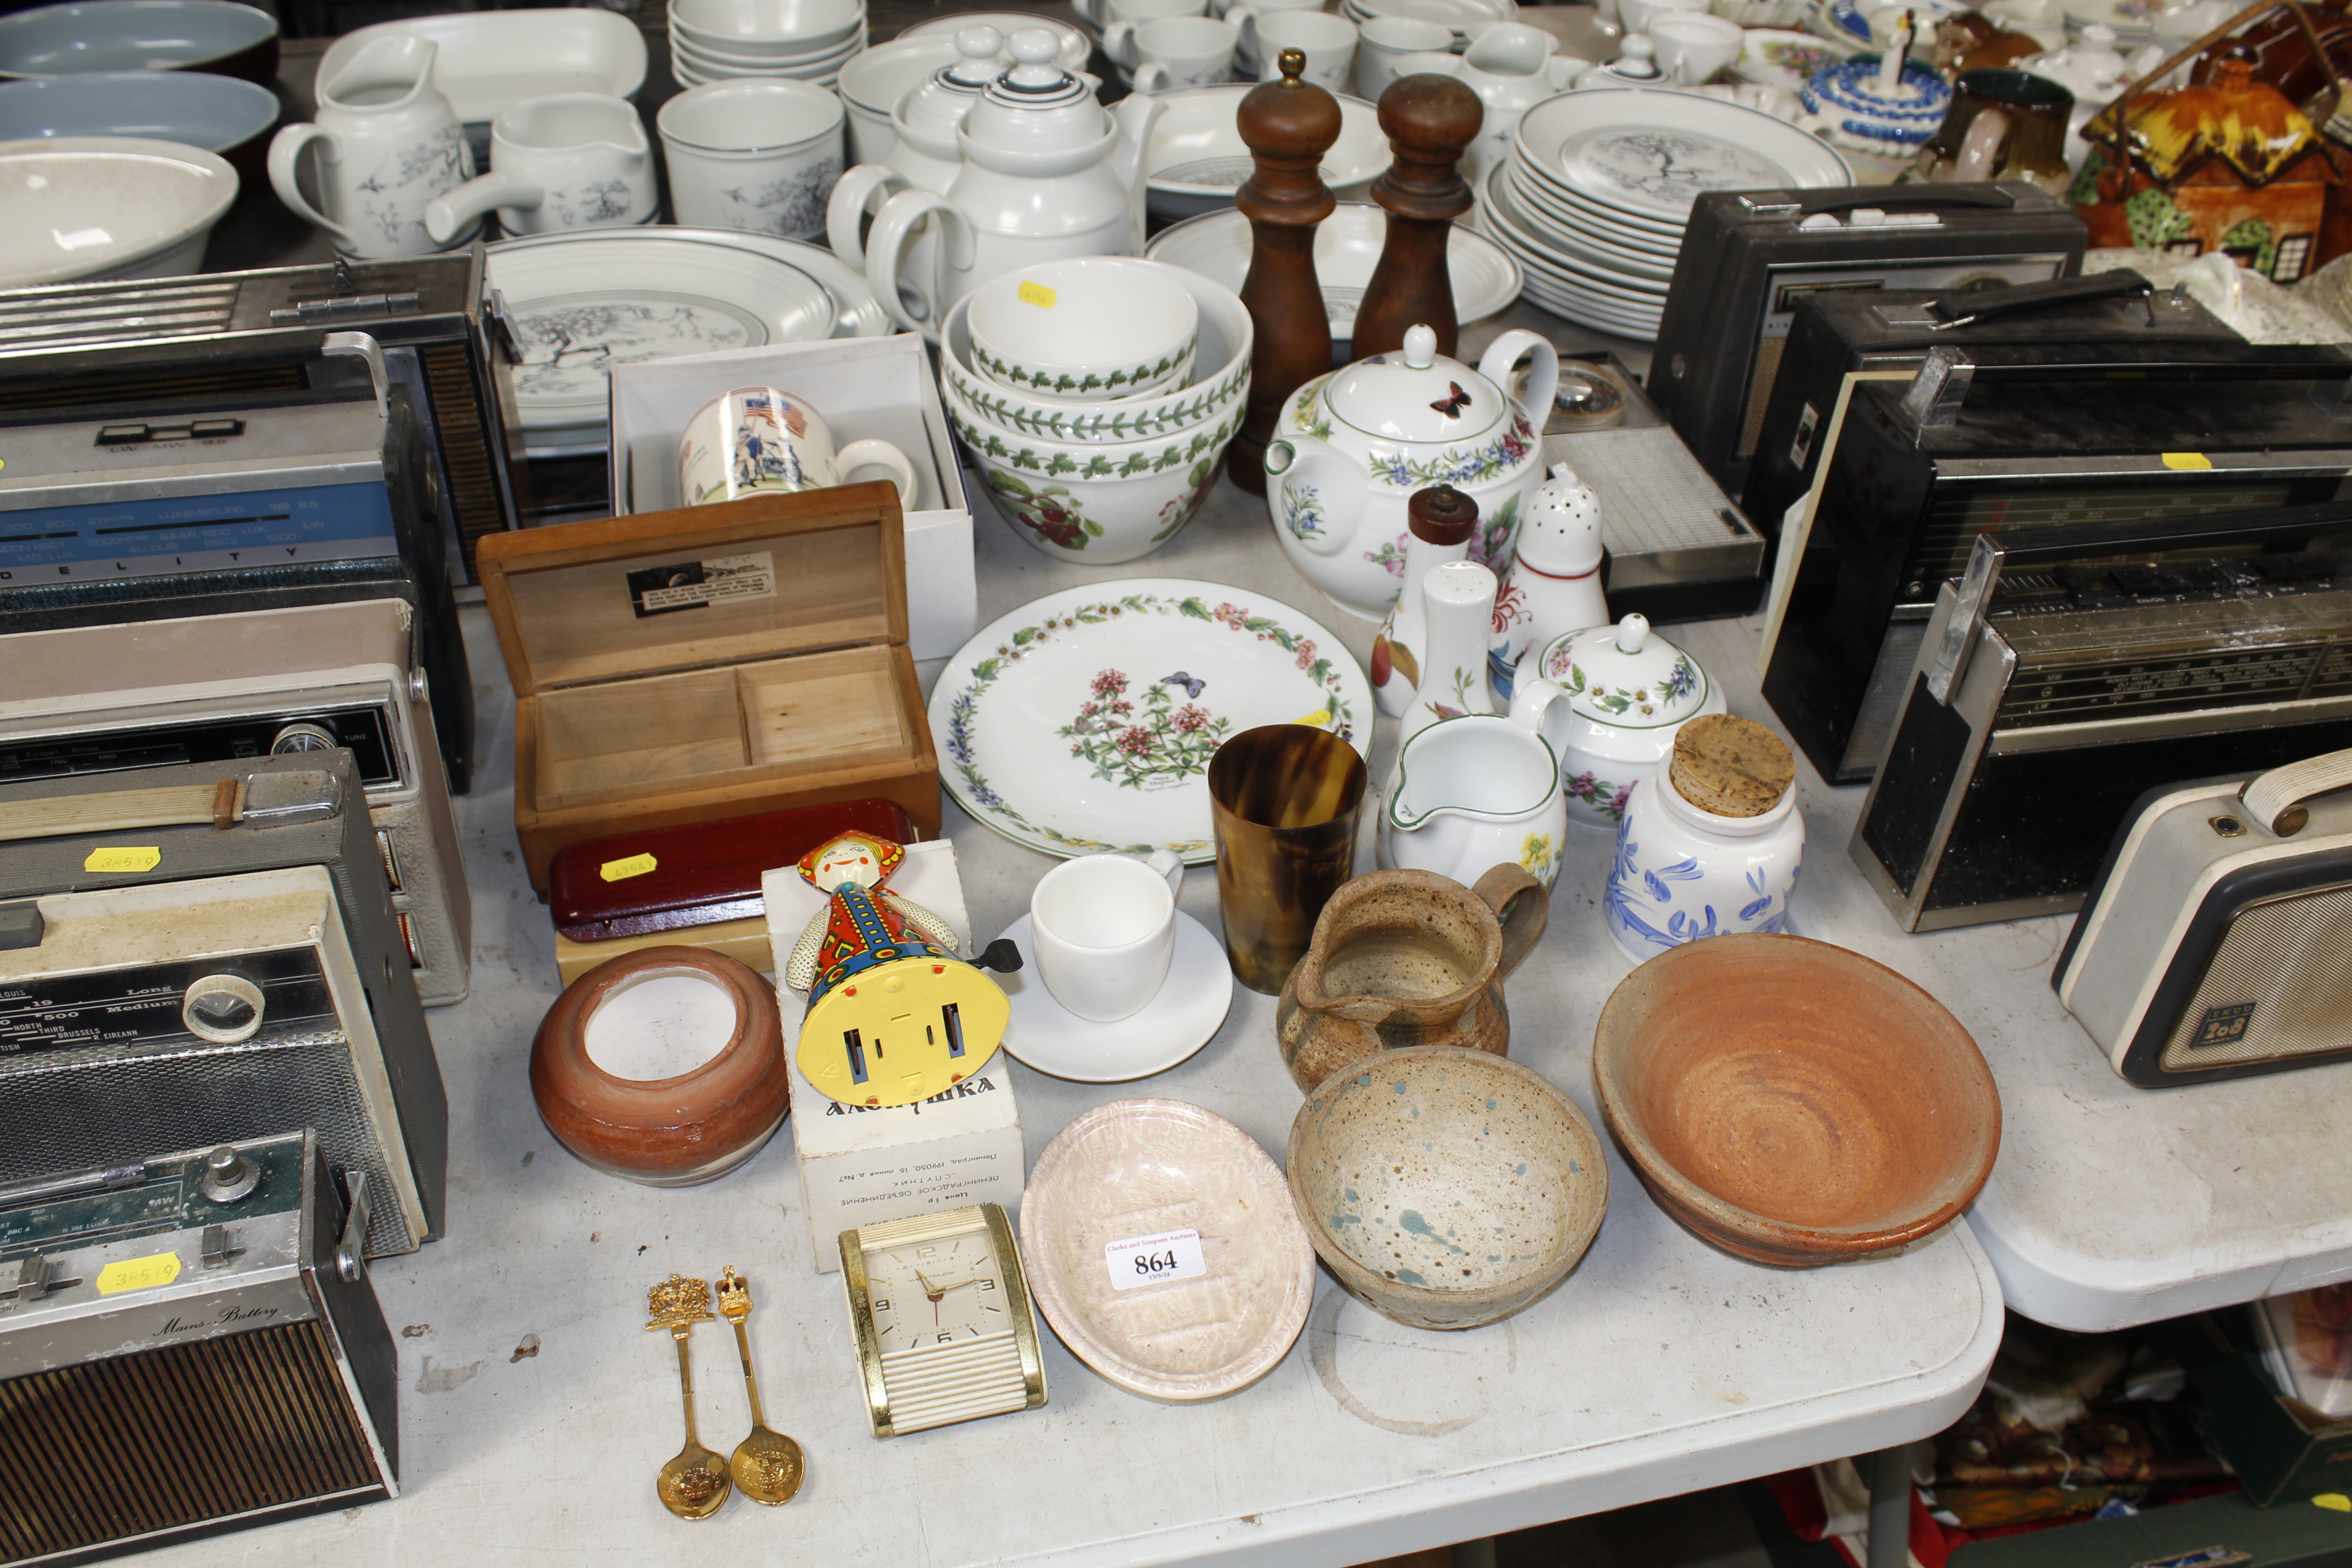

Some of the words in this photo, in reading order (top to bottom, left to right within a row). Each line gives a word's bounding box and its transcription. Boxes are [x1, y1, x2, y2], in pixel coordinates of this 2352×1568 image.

[344, 733, 367, 741] TUNE
[101, 856, 154, 868] 38519
[615, 860, 652, 877] 47541
[126, 985, 172, 996] Long
[44, 1012, 79, 1020] 500
[106, 1000, 178, 1013] Medium
[13, 1022, 42, 1031] NORTH
[38, 1026, 65, 1034] THIRD
[2205, 1018, 2245, 1039] 208
[58, 1028, 101, 1039] BRUSSELS
[104, 1029, 138, 1039] EIREANN
[870, 1168, 894, 1176] линия
[913, 1161, 945, 1172] 199050,
[917, 1174, 1000, 1194] ЛЕНИНГРАДСКОЕ
[148, 1196, 175, 1207] MW
[841, 1190, 912, 1206] ОБЪЕДИНЕНИЕ
[945, 1192, 968, 1201] Цена
[1107, 1243, 1128, 1252] Clarke
[1141, 1236, 1168, 1248] Simpson
[1169, 1232, 1196, 1241] Auctions
[916, 1245, 937, 1260] 12
[1134, 1250, 1179, 1275] 864
[116, 1264, 174, 1287] 38519
[907, 1270, 955, 1283] WETCLOX
[1148, 1272, 1171, 1280] 13/5/24
[980, 1279, 995, 1291] 3
[875, 1299, 890, 1312] 9
